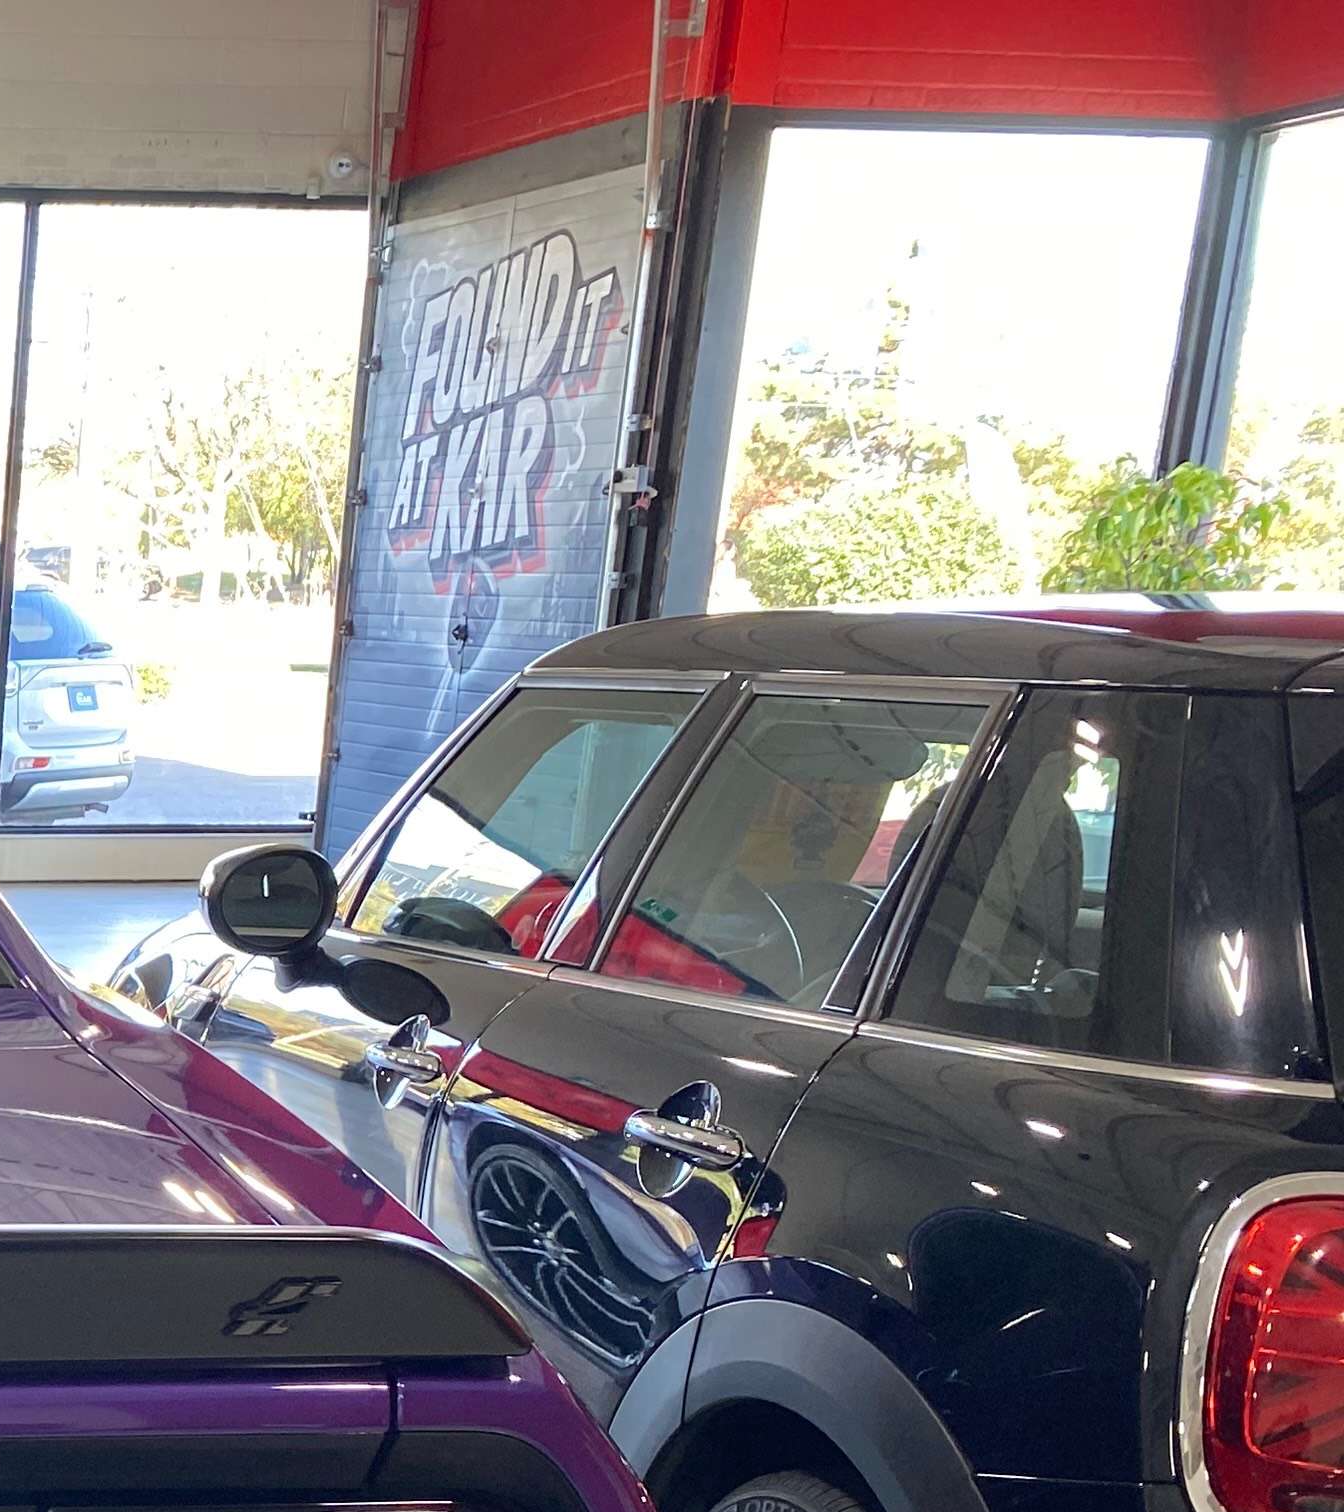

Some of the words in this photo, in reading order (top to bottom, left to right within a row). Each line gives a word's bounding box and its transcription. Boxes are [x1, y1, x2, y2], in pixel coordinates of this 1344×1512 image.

[402, 230, 578, 441] FOUND
[561, 270, 616, 376] IT
[388, 440, 437, 530] AT
[430, 398, 549, 559] KAR
